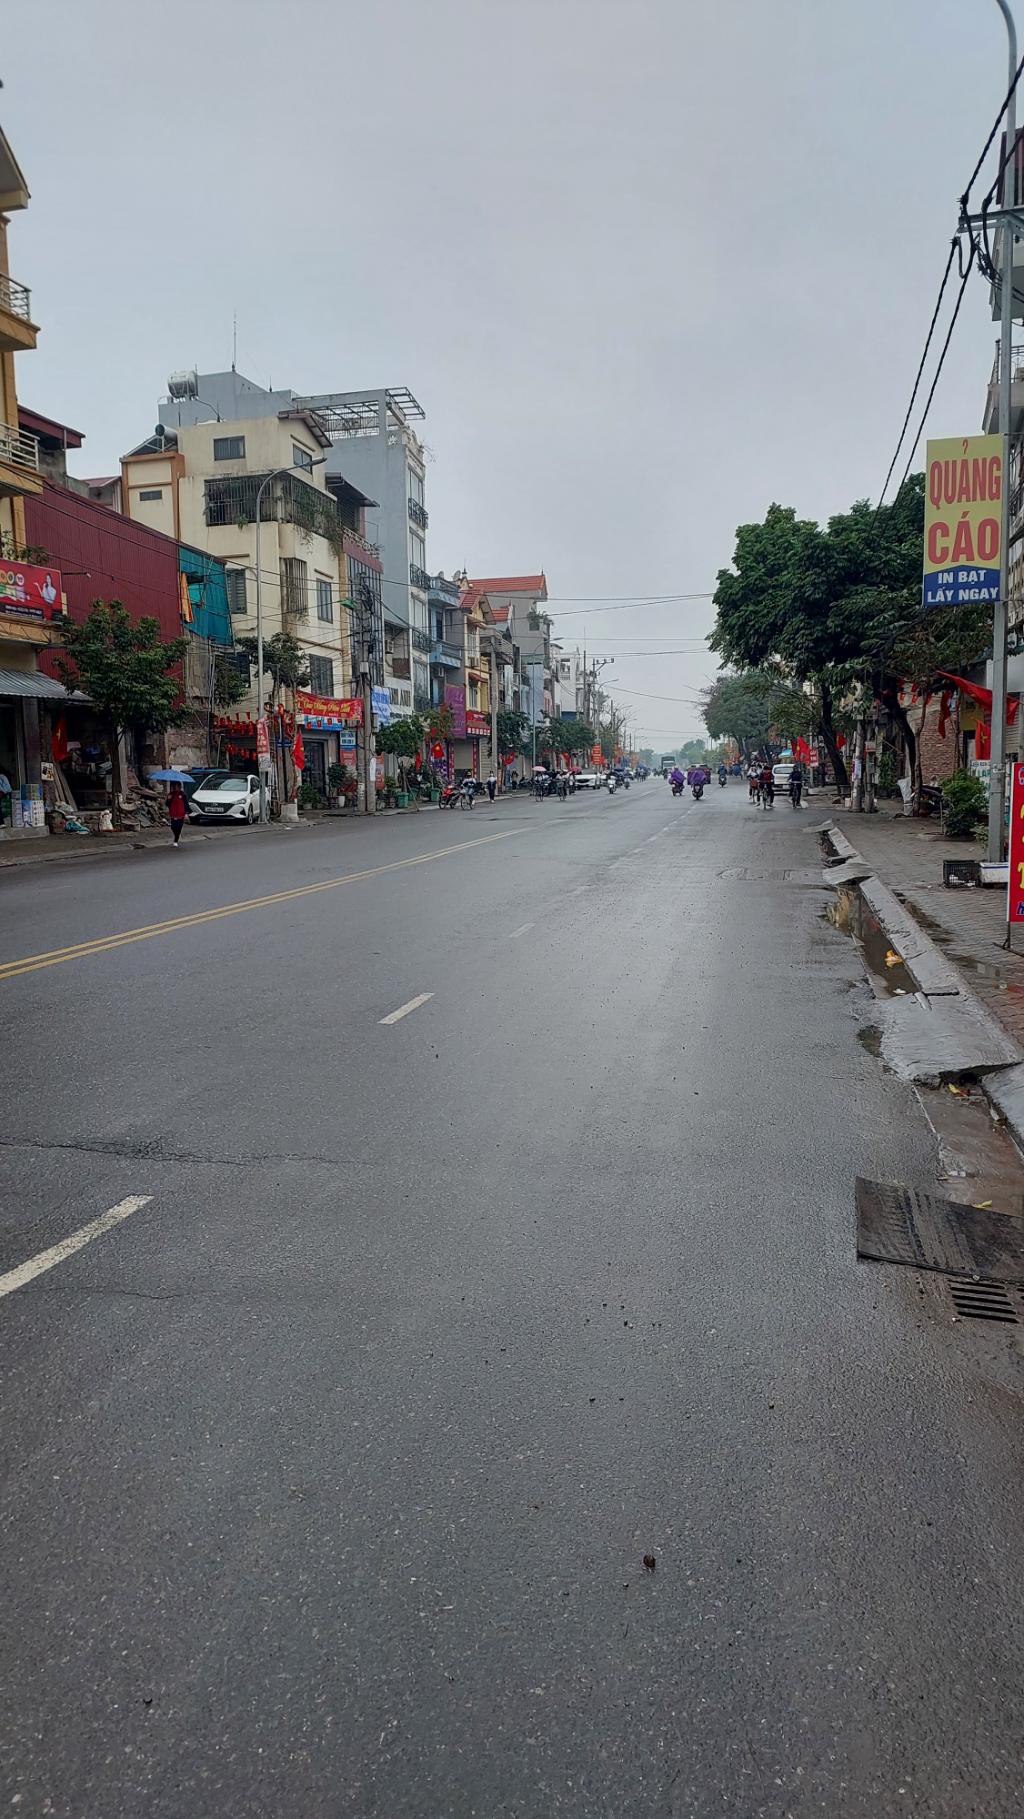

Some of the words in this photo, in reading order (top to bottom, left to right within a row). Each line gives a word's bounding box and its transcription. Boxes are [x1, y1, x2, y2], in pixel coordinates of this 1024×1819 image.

[929, 438, 1001, 510] QUẢNG
[928, 511, 1000, 565] CÁO
[927, 586, 954, 603] LẤY
[958, 587, 999, 601] NGAY
[938, 571, 953, 584] IN
[958, 569, 987, 585] BẠT
